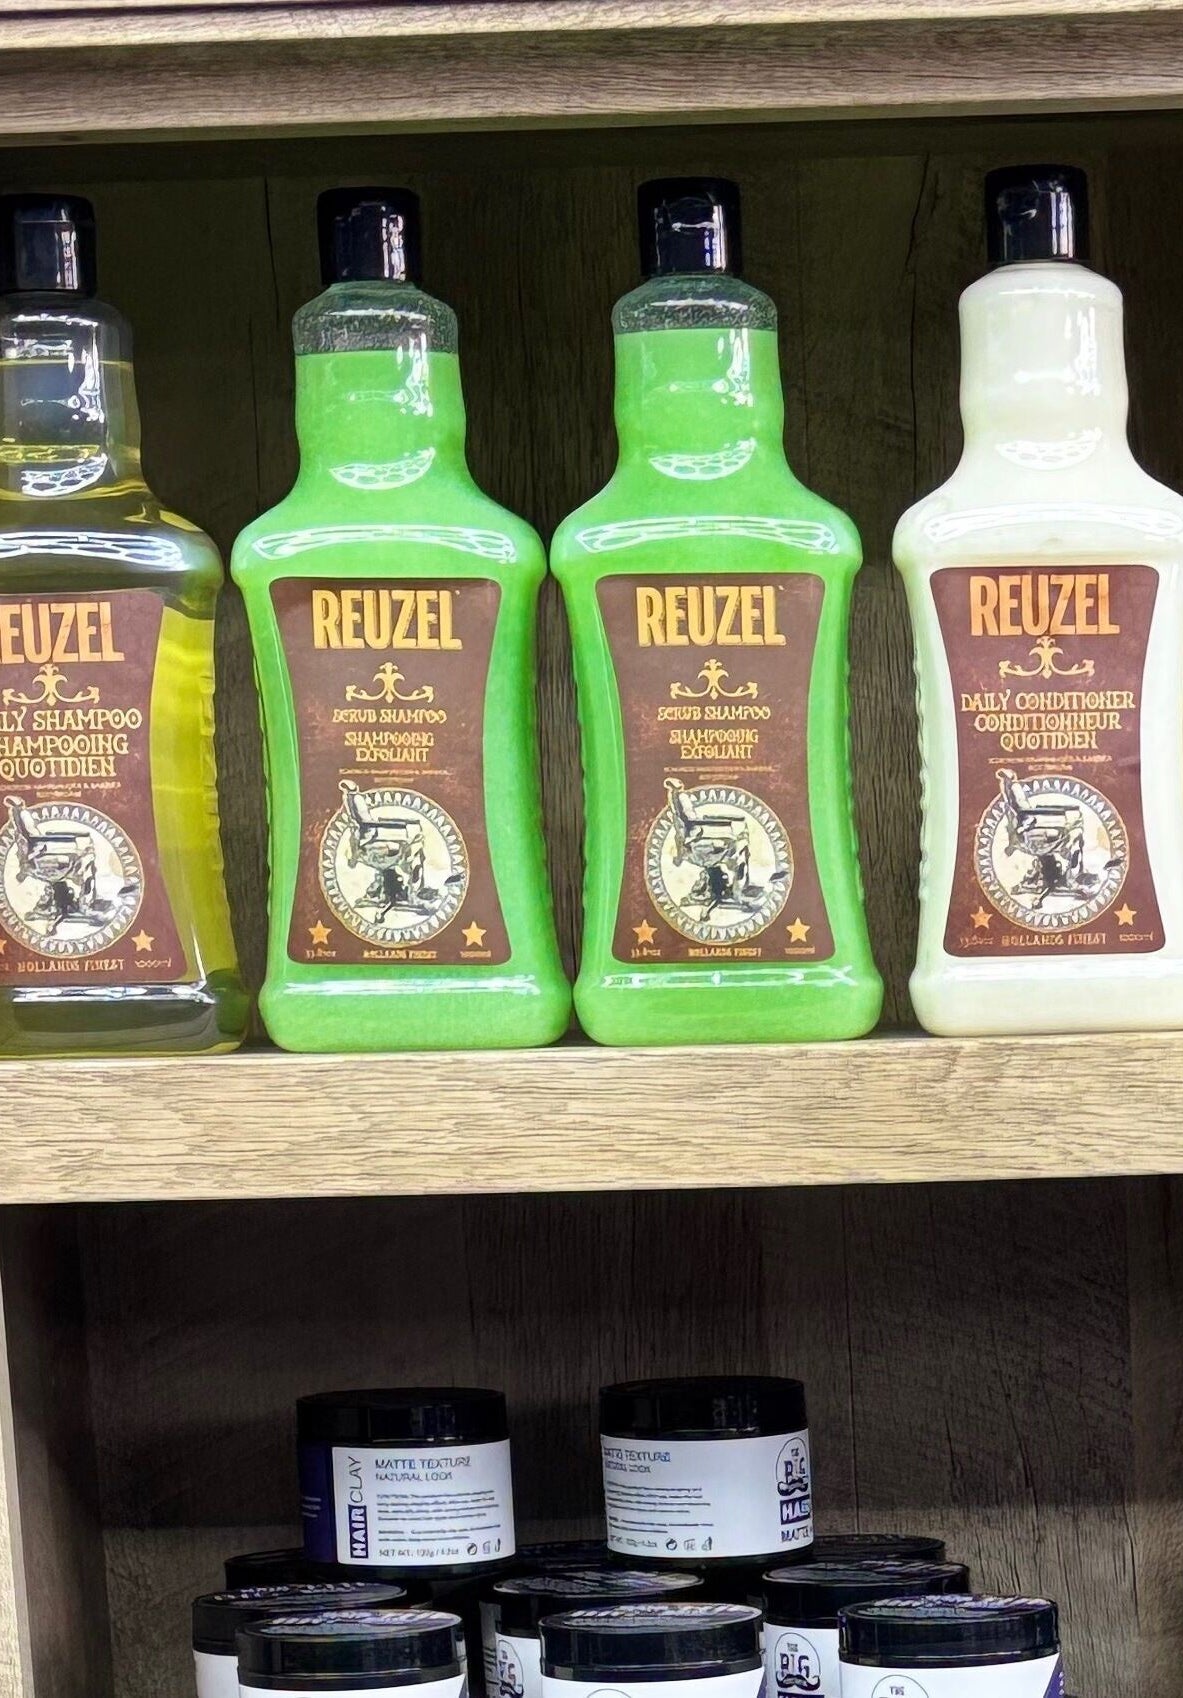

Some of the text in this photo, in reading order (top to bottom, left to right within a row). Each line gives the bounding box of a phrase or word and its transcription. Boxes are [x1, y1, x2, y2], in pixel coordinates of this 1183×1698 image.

[636, 585, 787, 647] REUZEL
[969, 573, 1120, 637] REUZEL
[312, 589, 463, 650] REUZEL
[0, 602, 125, 664] EUZEL
[961, 689, 1136, 711] DAILY CONDITIONER
[32, 708, 143, 730] SHAMPOO
[704, 706, 771, 721] SHAMPOO
[974, 711, 1122, 732] CONDITIONNEUR
[0, 733, 129, 757] HAMPOOING
[1000, 731, 1099, 752] QUOTIDIEN
[0, 756, 117, 782] QUOTIDIEN
[348, 1456, 366, 1557] HAIR CLAY
